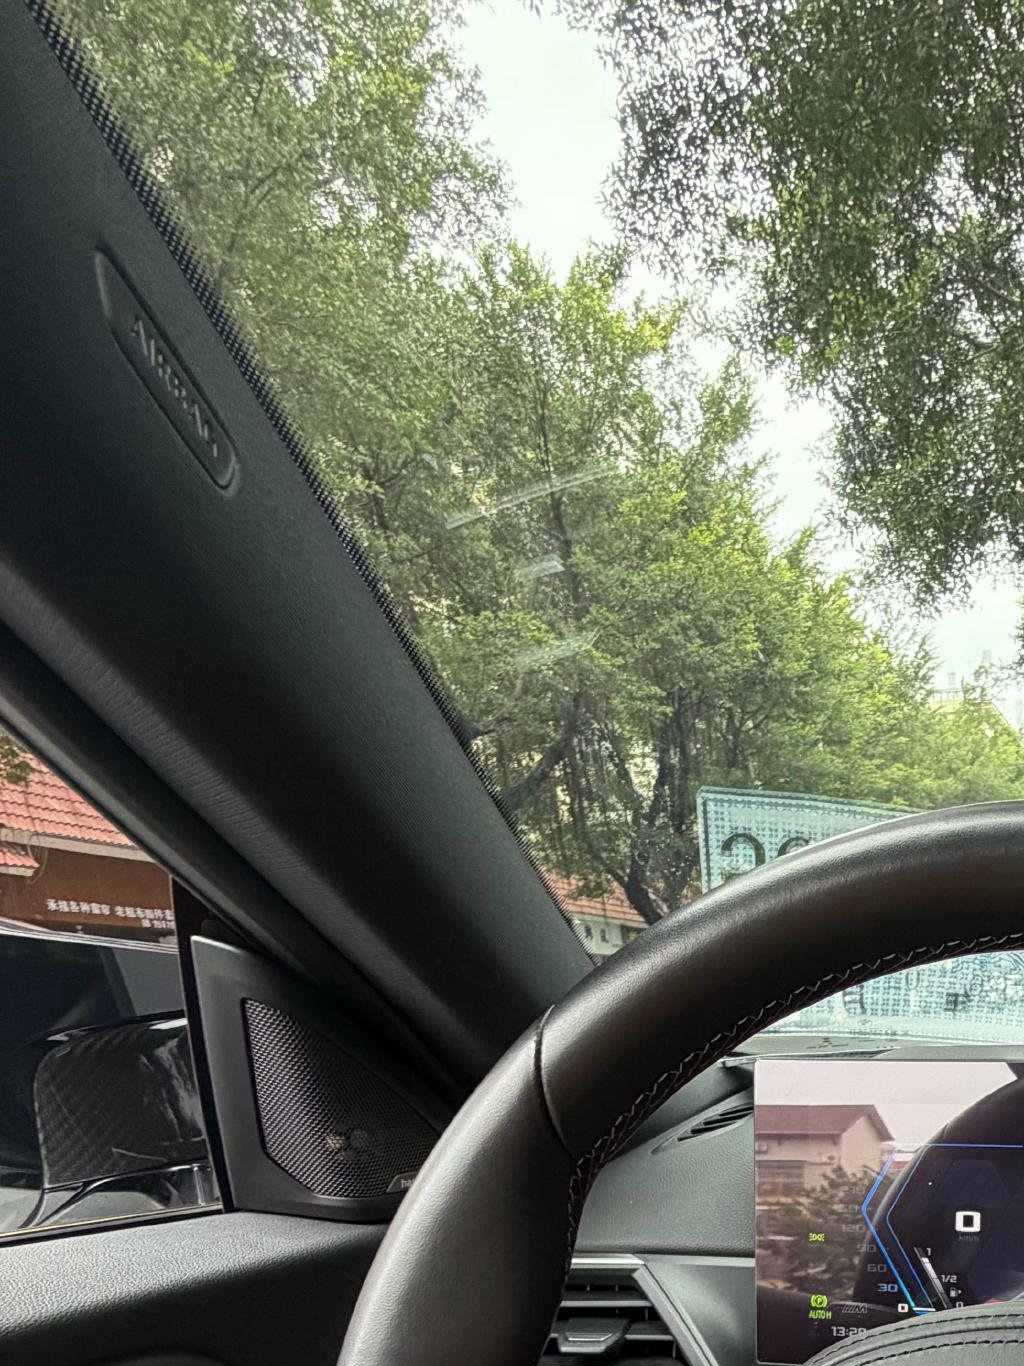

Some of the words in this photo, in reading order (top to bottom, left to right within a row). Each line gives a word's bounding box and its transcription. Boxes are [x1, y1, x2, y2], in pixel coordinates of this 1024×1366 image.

[867, 1264, 887, 1273] 60
[940, 1274, 958, 1283] 1/2
[877, 1283, 898, 1293] 30
[898, 1303, 909, 1313] 0
